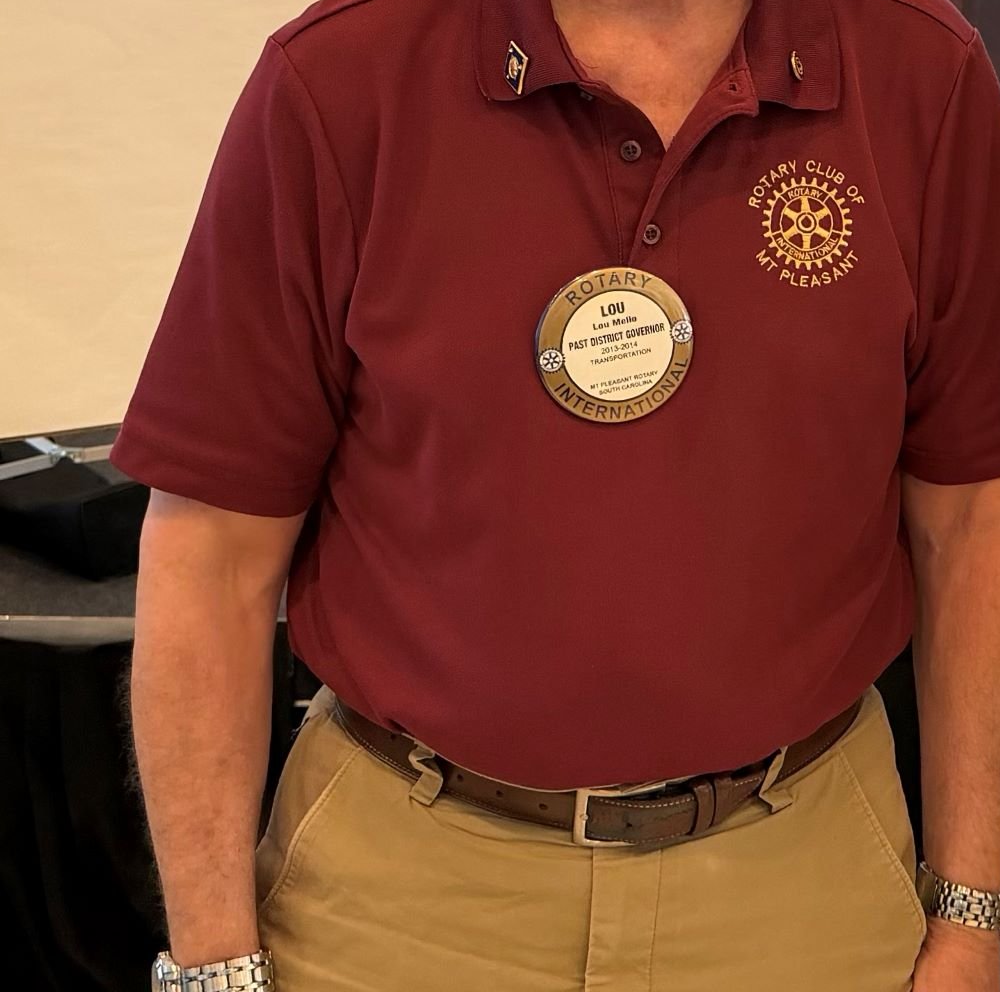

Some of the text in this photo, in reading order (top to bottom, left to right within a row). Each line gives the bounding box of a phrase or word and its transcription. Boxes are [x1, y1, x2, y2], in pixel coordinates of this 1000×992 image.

[748, 160, 865, 208] ROTARY CLUB OF
[788, 188, 822, 199] ROTARY
[776, 237, 838, 260] INTERNATIONAL
[756, 249, 859, 288] MT PLEASANT
[565, 272, 652, 306] ROTARY
[600, 302, 625, 317] LOU
[592, 316, 637, 330] Lou Mello
[568, 323, 665, 351] PAST DISTRICT GOVERNOR
[601, 341, 638, 354] 2013-2014
[590, 348, 652, 365] TRANSPORTATION
[599, 379, 653, 395] SOUTH CAROLINA
[601, 376, 632, 387] PLEASANT
[634, 370, 658, 380] ROTARY
[554, 358, 689, 420] INTERNATIONAL
